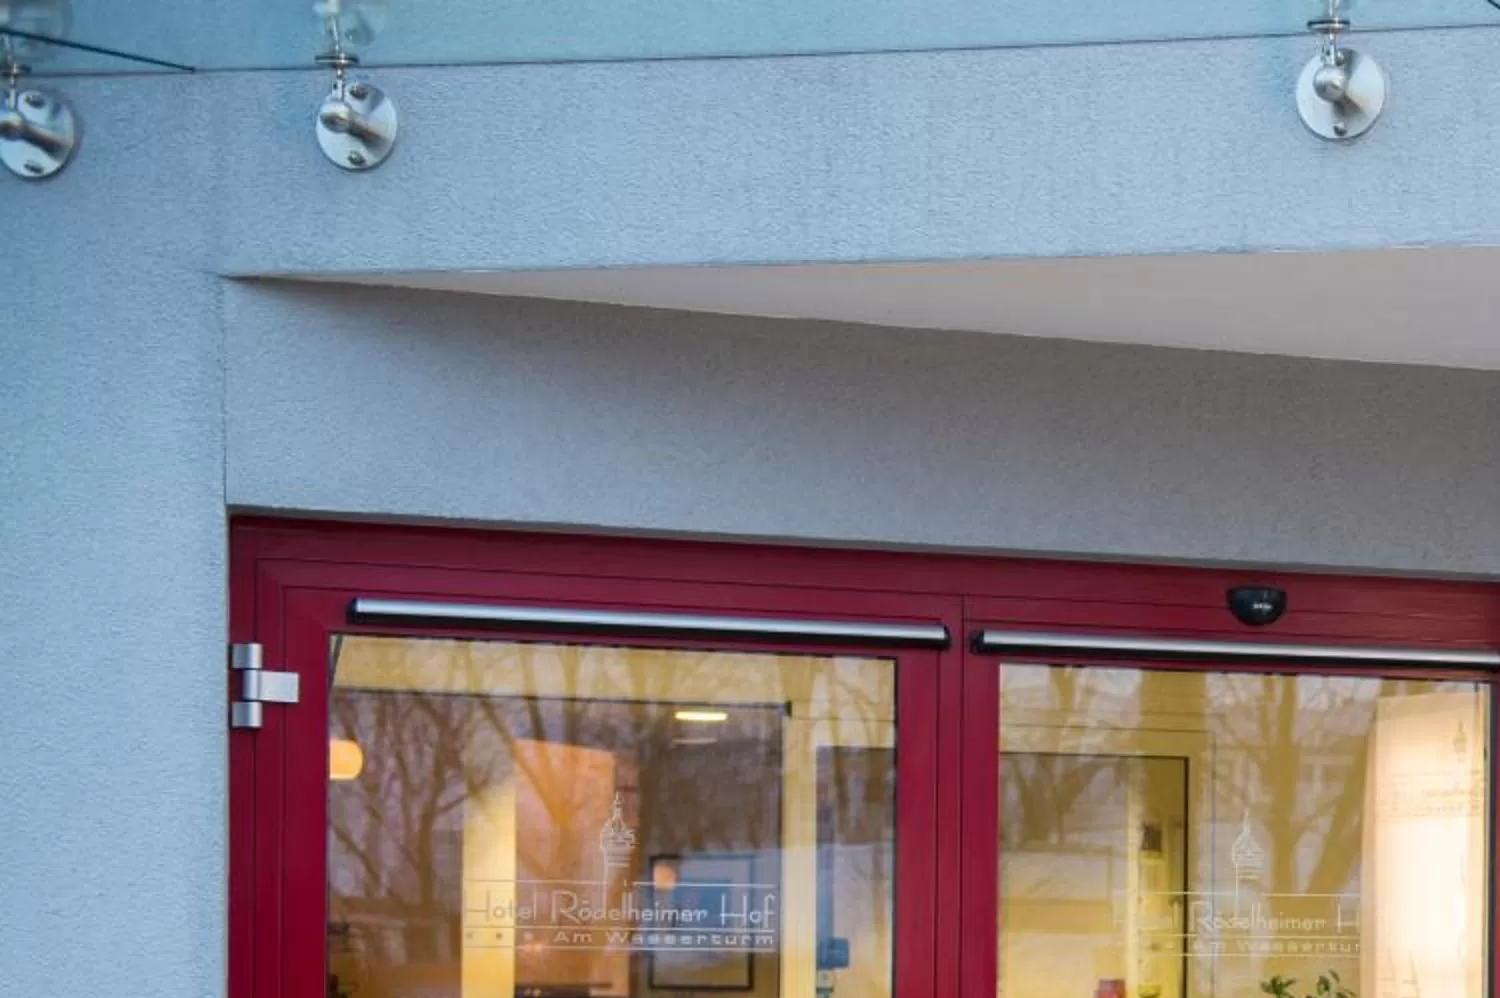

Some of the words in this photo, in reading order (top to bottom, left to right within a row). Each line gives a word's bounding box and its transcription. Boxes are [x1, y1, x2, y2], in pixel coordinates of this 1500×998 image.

[465, 887, 538, 922] Hotel
[551, 889, 708, 925] Rödelheimer
[720, 892, 775, 930] Hof
[553, 930, 593, 943] Am
[606, 930, 774, 946] Wasserturm
[1236, 939, 1360, 954] Wassertur
